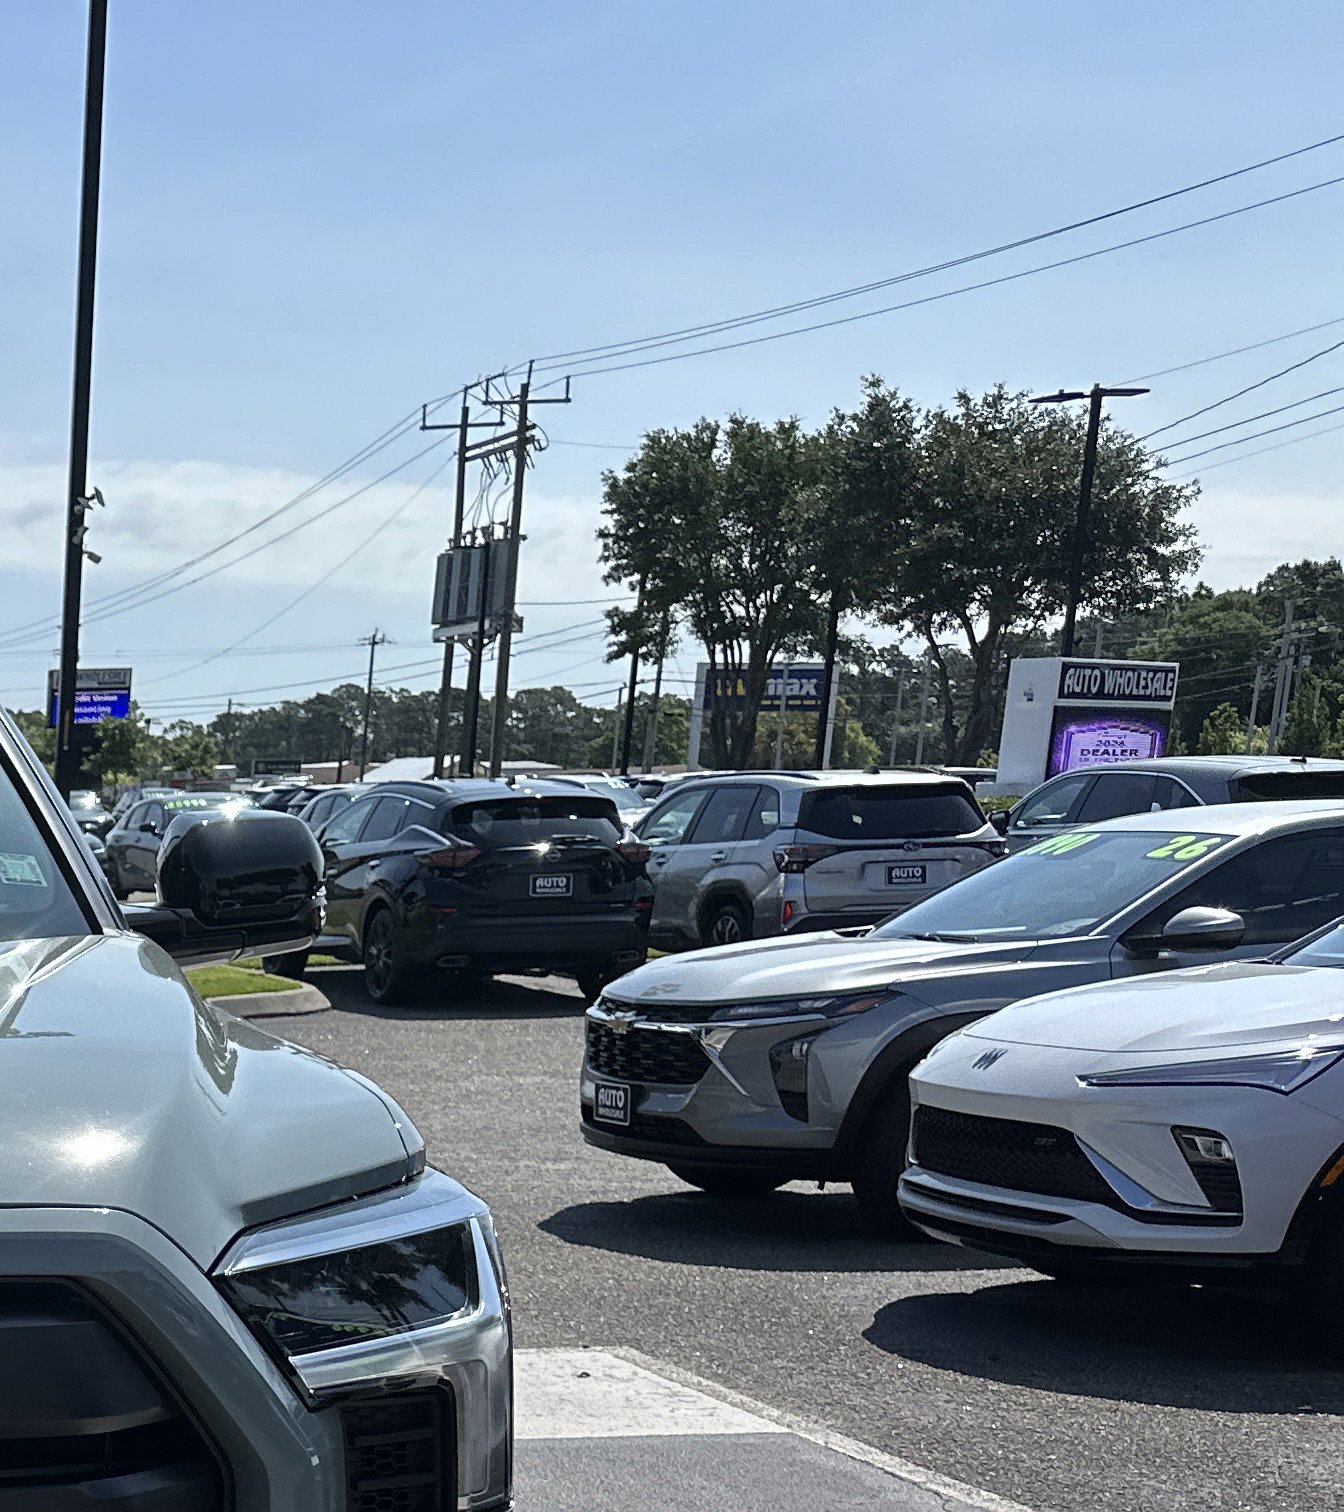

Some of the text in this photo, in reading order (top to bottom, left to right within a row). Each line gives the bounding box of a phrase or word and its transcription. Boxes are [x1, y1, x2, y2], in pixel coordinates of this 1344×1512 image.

[1064, 668, 1175, 697] AUTO WHOLESALE
[1080, 748, 1139, 757] DEALER
[1146, 836, 1221, 860] 26
[892, 867, 922, 878] AUTO
[536, 877, 567, 887] AUTO
[598, 1087, 625, 1108] AUTO
